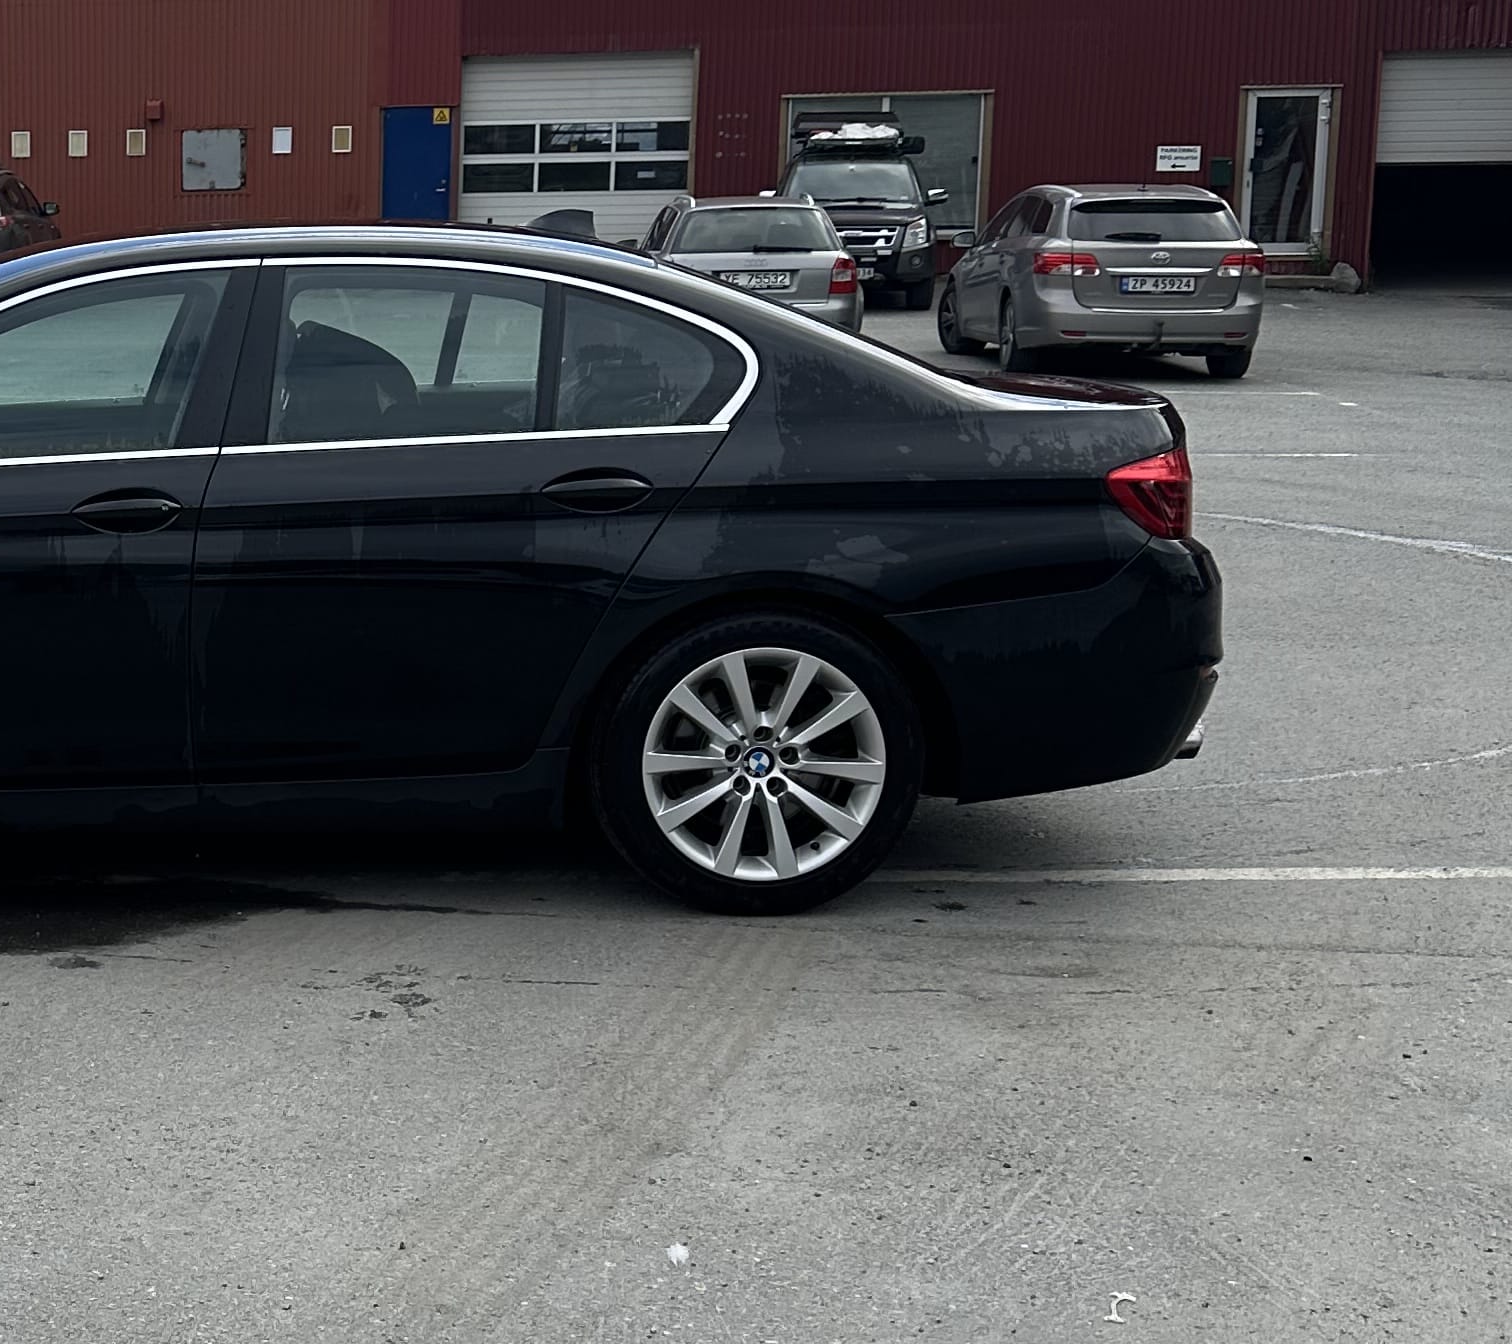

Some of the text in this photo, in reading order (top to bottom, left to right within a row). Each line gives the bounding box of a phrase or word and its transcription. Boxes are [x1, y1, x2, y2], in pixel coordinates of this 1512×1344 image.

[747, 273, 787, 285] 75532
[1131, 278, 1191, 289] ZP 45924
